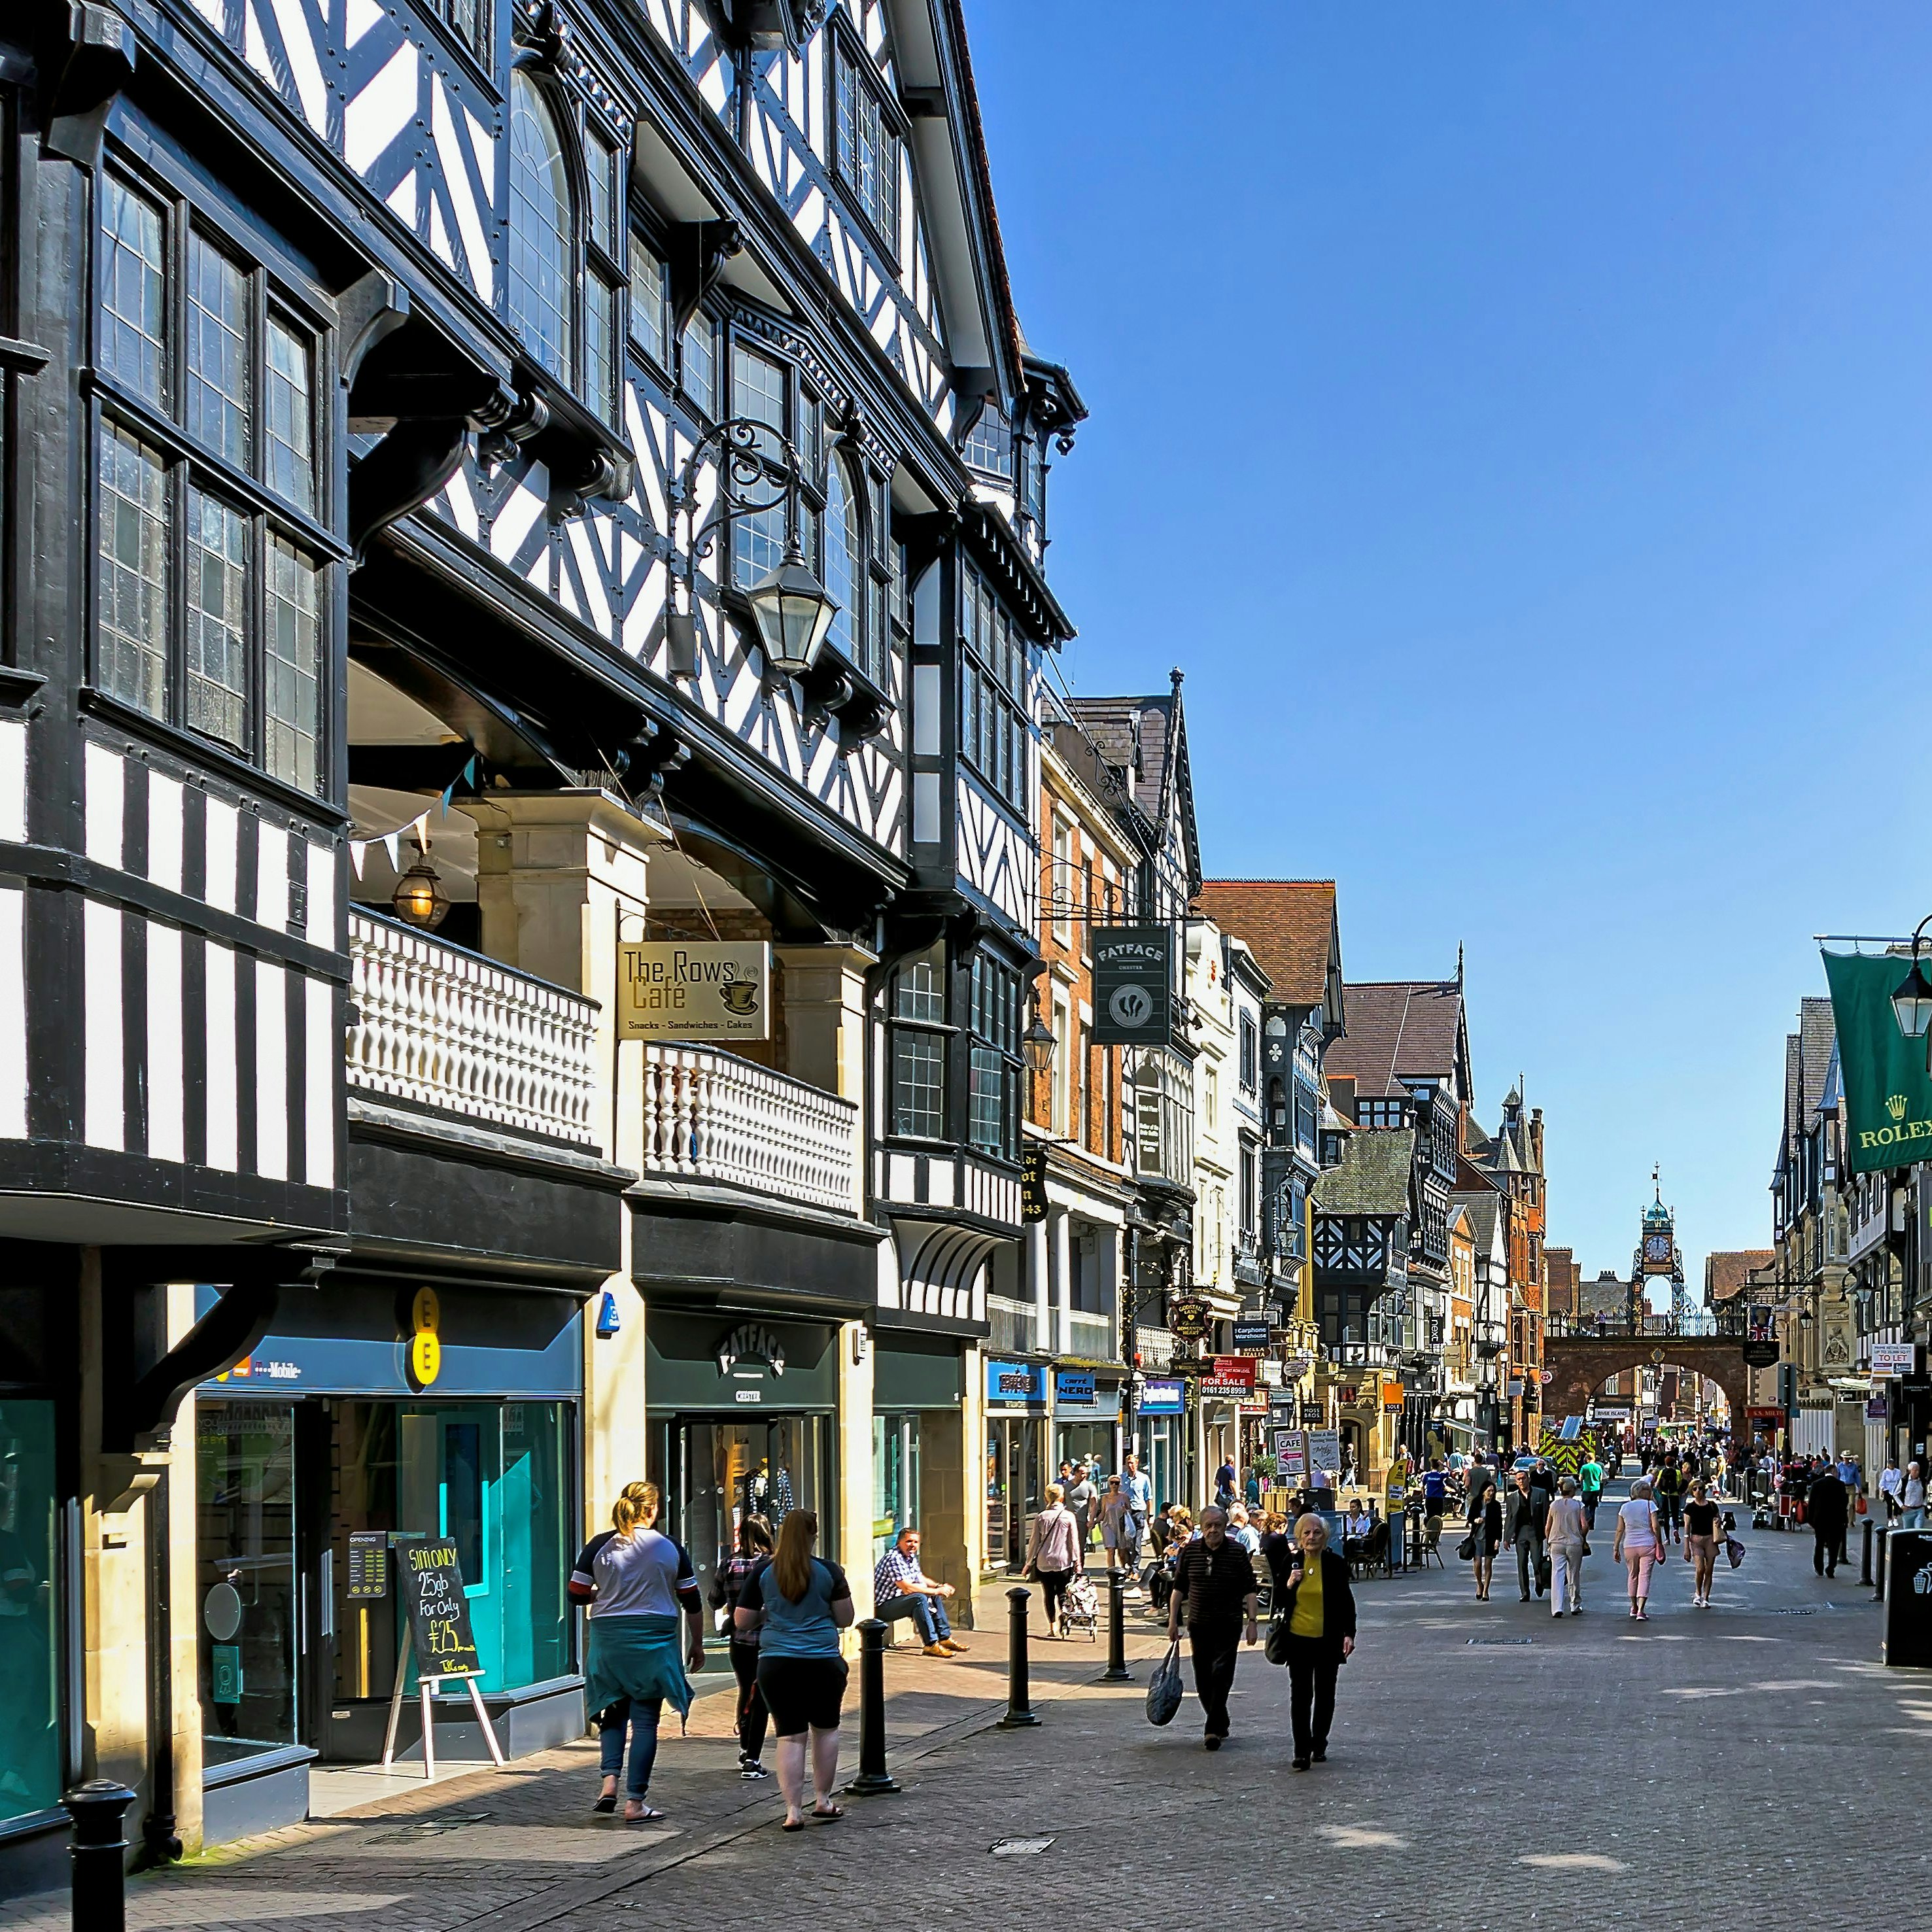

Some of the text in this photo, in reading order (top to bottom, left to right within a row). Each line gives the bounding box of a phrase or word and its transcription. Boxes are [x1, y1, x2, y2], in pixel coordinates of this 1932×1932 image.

[1097, 944, 1164, 962] FATFACE
[624, 950, 734, 982] The Rows
[633, 976, 686, 1009] Café
[629, 1020, 659, 1029] Snacks
[668, 1020, 718, 1029] Sandwiches
[727, 1020, 752, 1029] Cakes
[1280, 1439, 1301, 1447] CAFE
[418, 1571, 449, 1598] 25gb
[419, 1597, 460, 1621] For Only
[427, 1619, 459, 1654] £25
